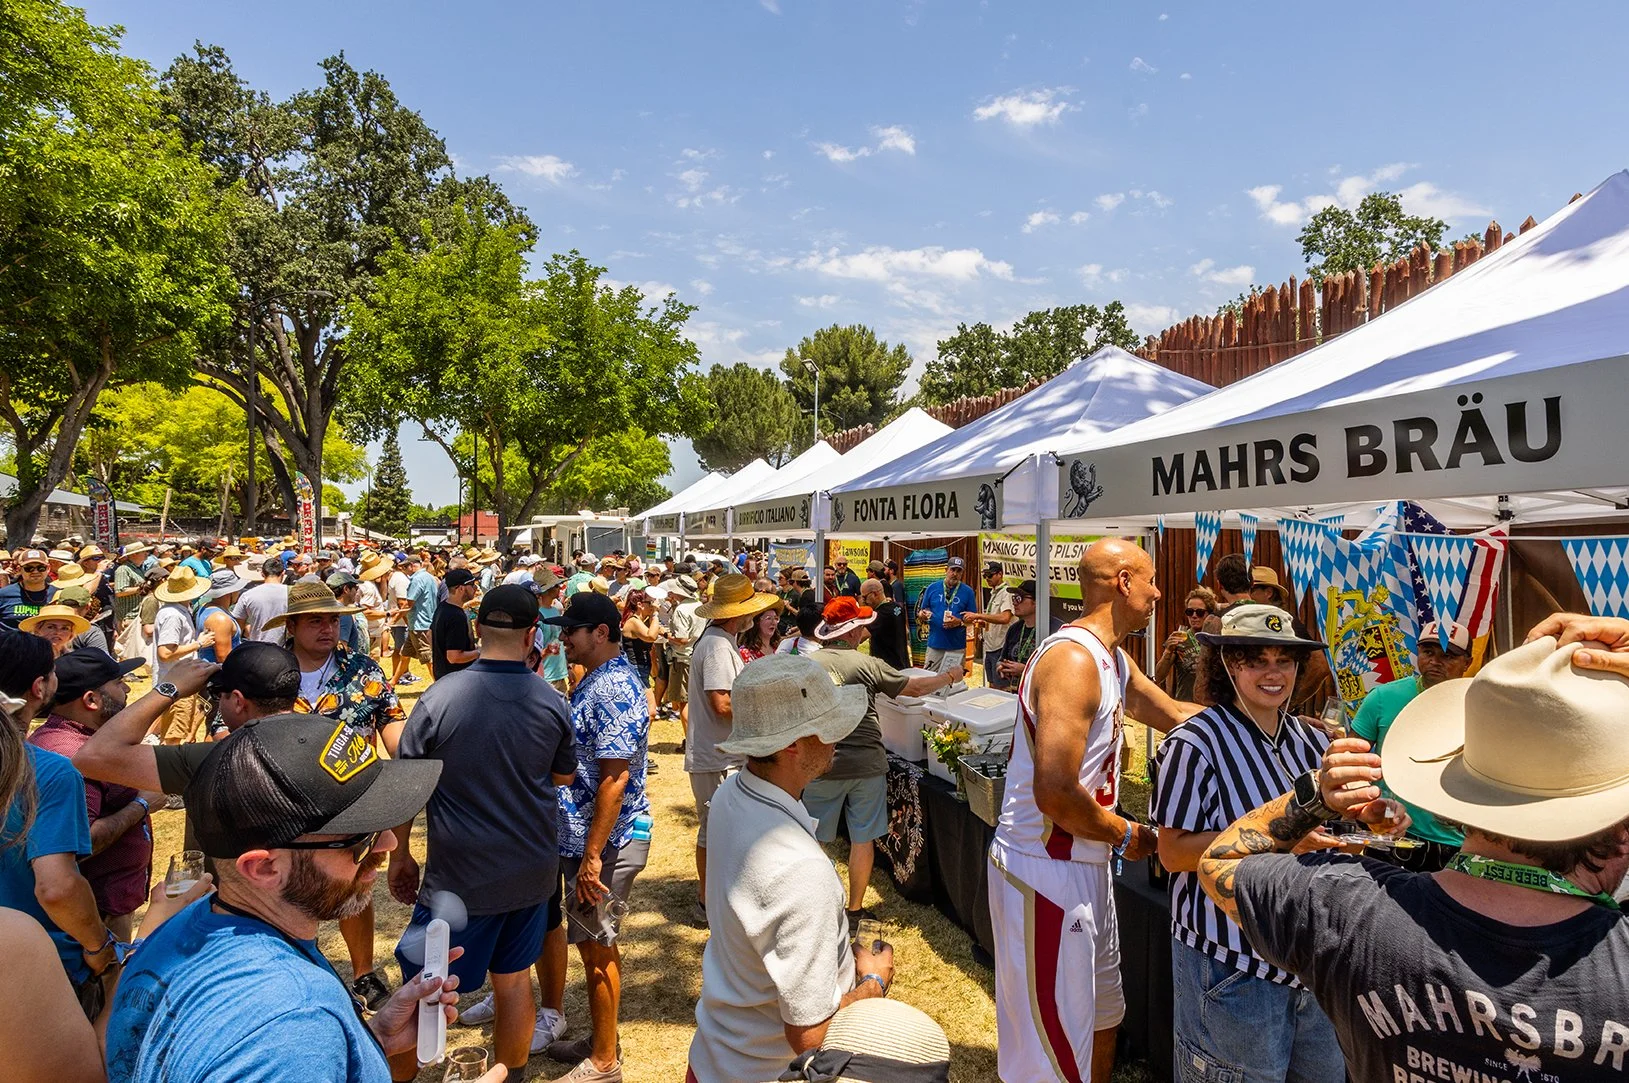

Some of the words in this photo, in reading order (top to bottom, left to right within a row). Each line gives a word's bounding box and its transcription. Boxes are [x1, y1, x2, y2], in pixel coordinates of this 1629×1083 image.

[1152, 433, 1320, 496] MAHRS
[1344, 392, 1562, 478] BRÄU
[765, 505, 796, 524] ITALIANO
[854, 497, 897, 521] FONTA
[903, 491, 959, 520] FLORA
[983, 541, 1019, 556] MAKING
[1484, 864, 1513, 881] FEST
[1515, 871, 1550, 887] BEER
[1484, 1057, 1508, 1071] SINCE
